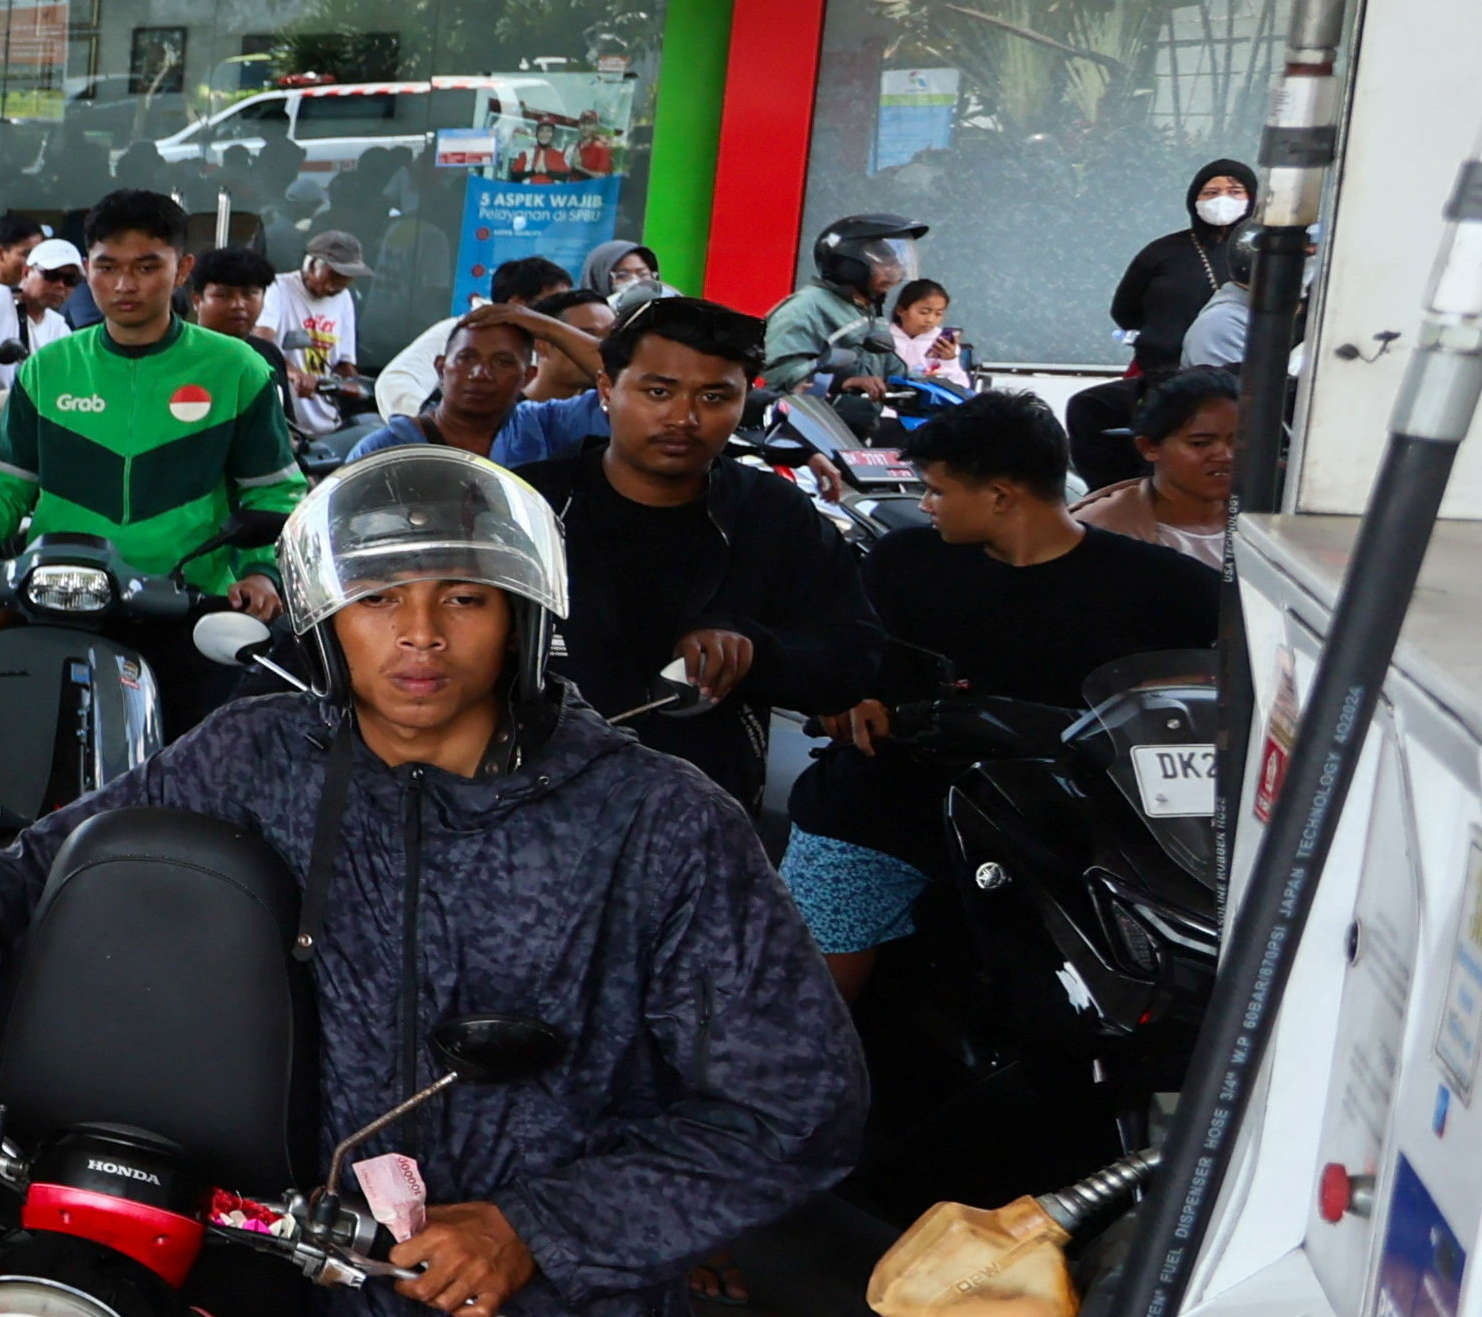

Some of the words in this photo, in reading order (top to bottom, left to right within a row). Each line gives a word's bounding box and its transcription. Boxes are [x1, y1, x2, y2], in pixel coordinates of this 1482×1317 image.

[480, 192, 490, 206] 5
[494, 193, 546, 207] ASPEK
[550, 194, 603, 208] WAJIB
[479, 208, 551, 223] Pelayanan
[57, 394, 106, 413] Grab
[1223, 562, 1233, 582] USA
[1156, 752, 1216, 780] DK2
[1160, 1246, 1183, 1285] FUEL
[1175, 1155, 1213, 1240] DISPENSER
[1205, 1107, 1230, 1151] HOSE
[1231, 1035, 1251, 1065] W.P
[1278, 867, 1305, 919] JAPAN
[1296, 752, 1341, 860] TECHNOLOGY
[1334, 685, 1366, 744] 4Q2024
[87, 1159, 161, 1187] HONDA
[955, 1260, 1002, 1295] OPW
